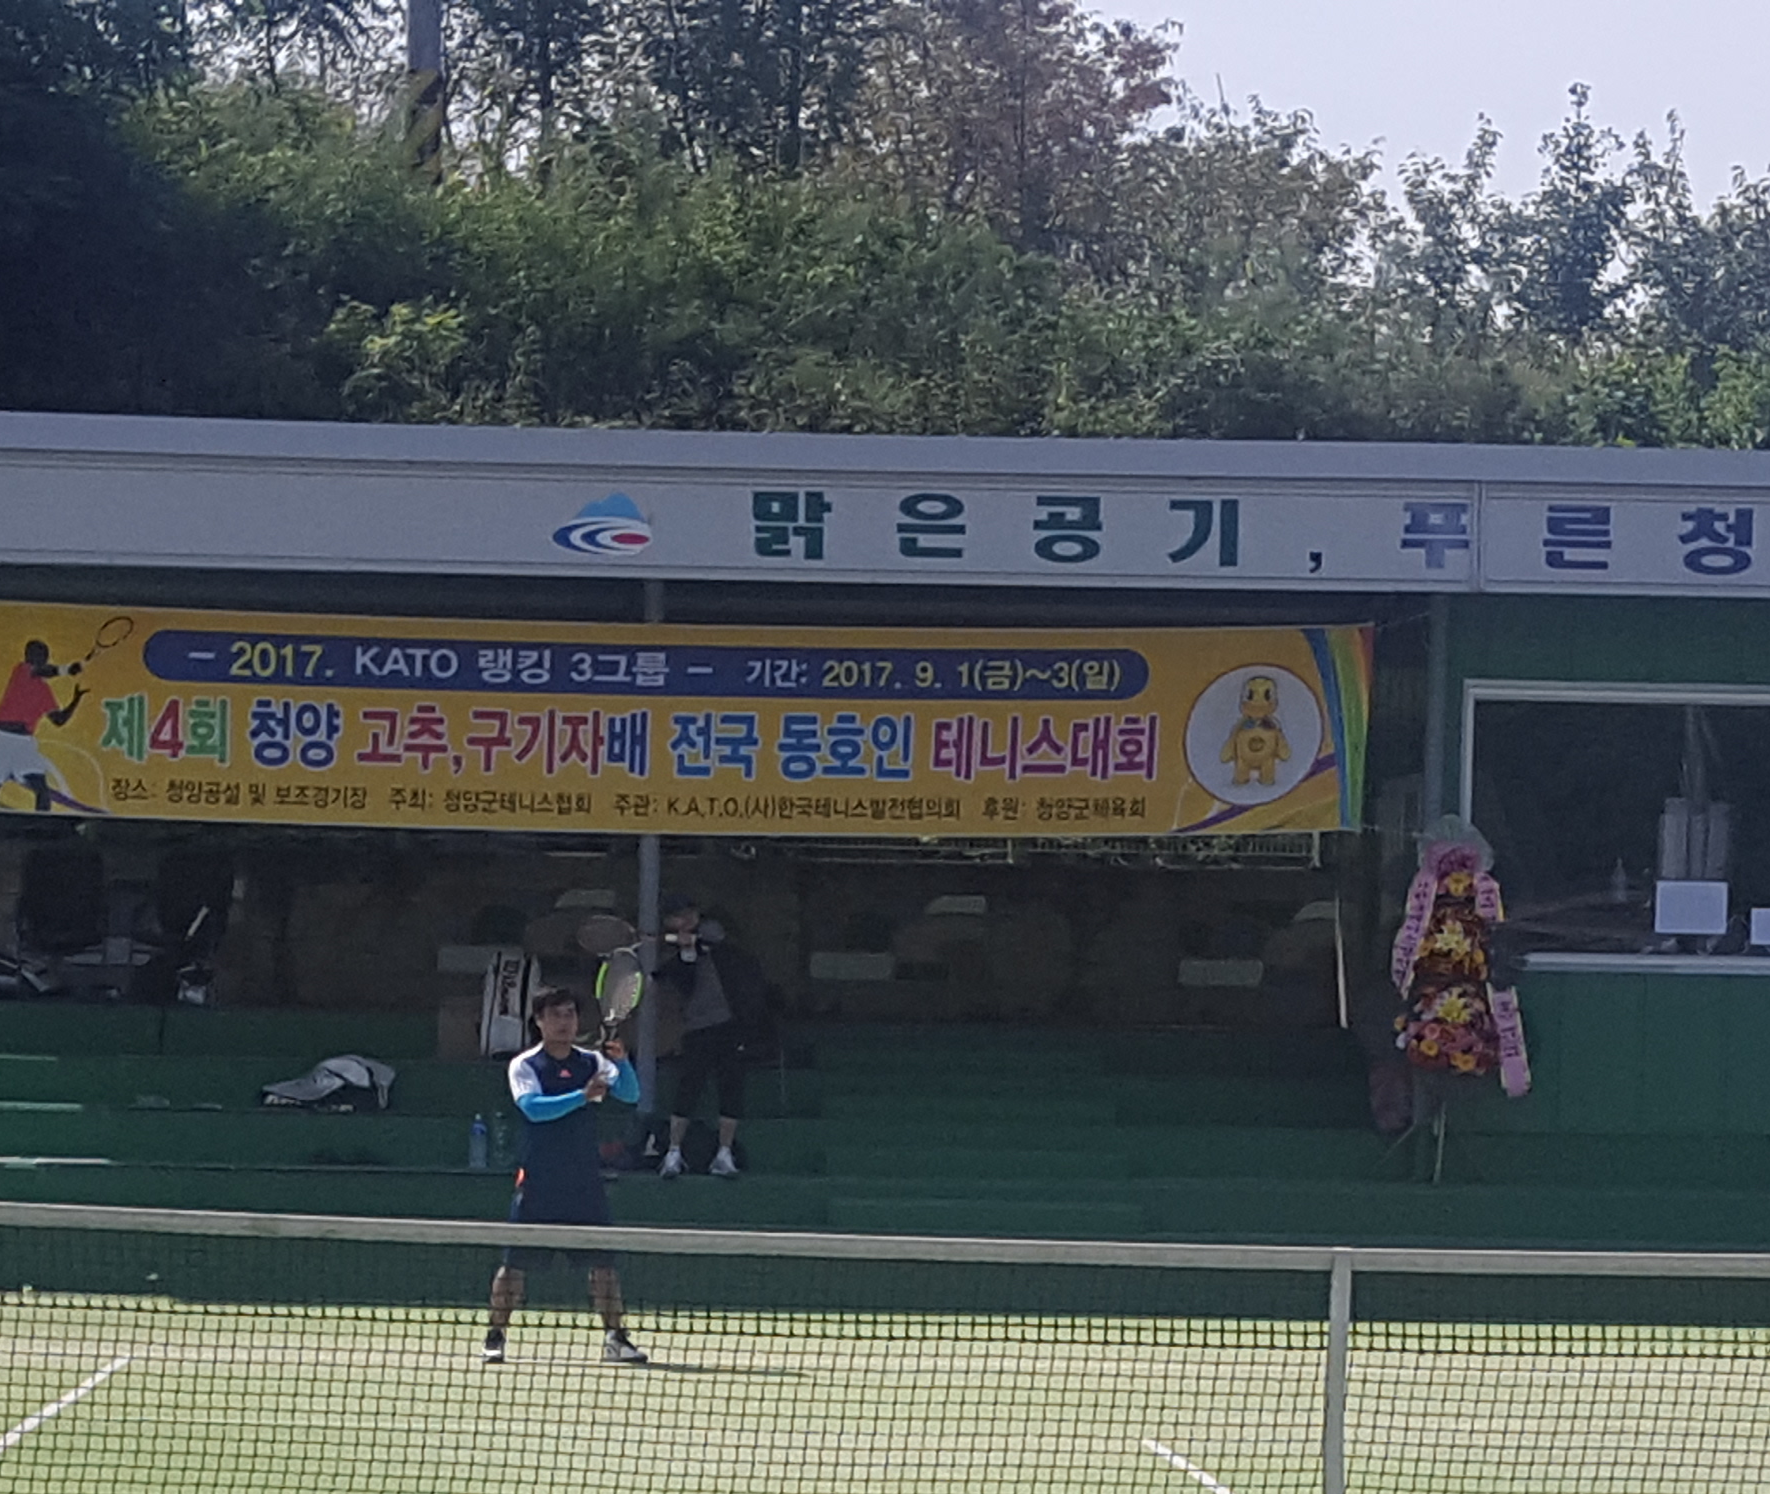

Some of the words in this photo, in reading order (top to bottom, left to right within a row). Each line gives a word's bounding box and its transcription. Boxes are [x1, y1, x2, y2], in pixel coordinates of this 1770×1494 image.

[229, 641, 334, 681] 2017.
[355, 645, 459, 679] KATO
[478, 648, 551, 684] 랭킹
[570, 651, 670, 687] 3그룹
[746, 658, 808, 688] 기간:
[822, 660, 902, 689] 2017.
[101, 694, 230, 765] 제4회
[249, 698, 341, 769] 청양
[668, 710, 760, 780] 전국
[776, 711, 914, 782] 동호인
[931, 714, 1159, 783] 테니스대회
